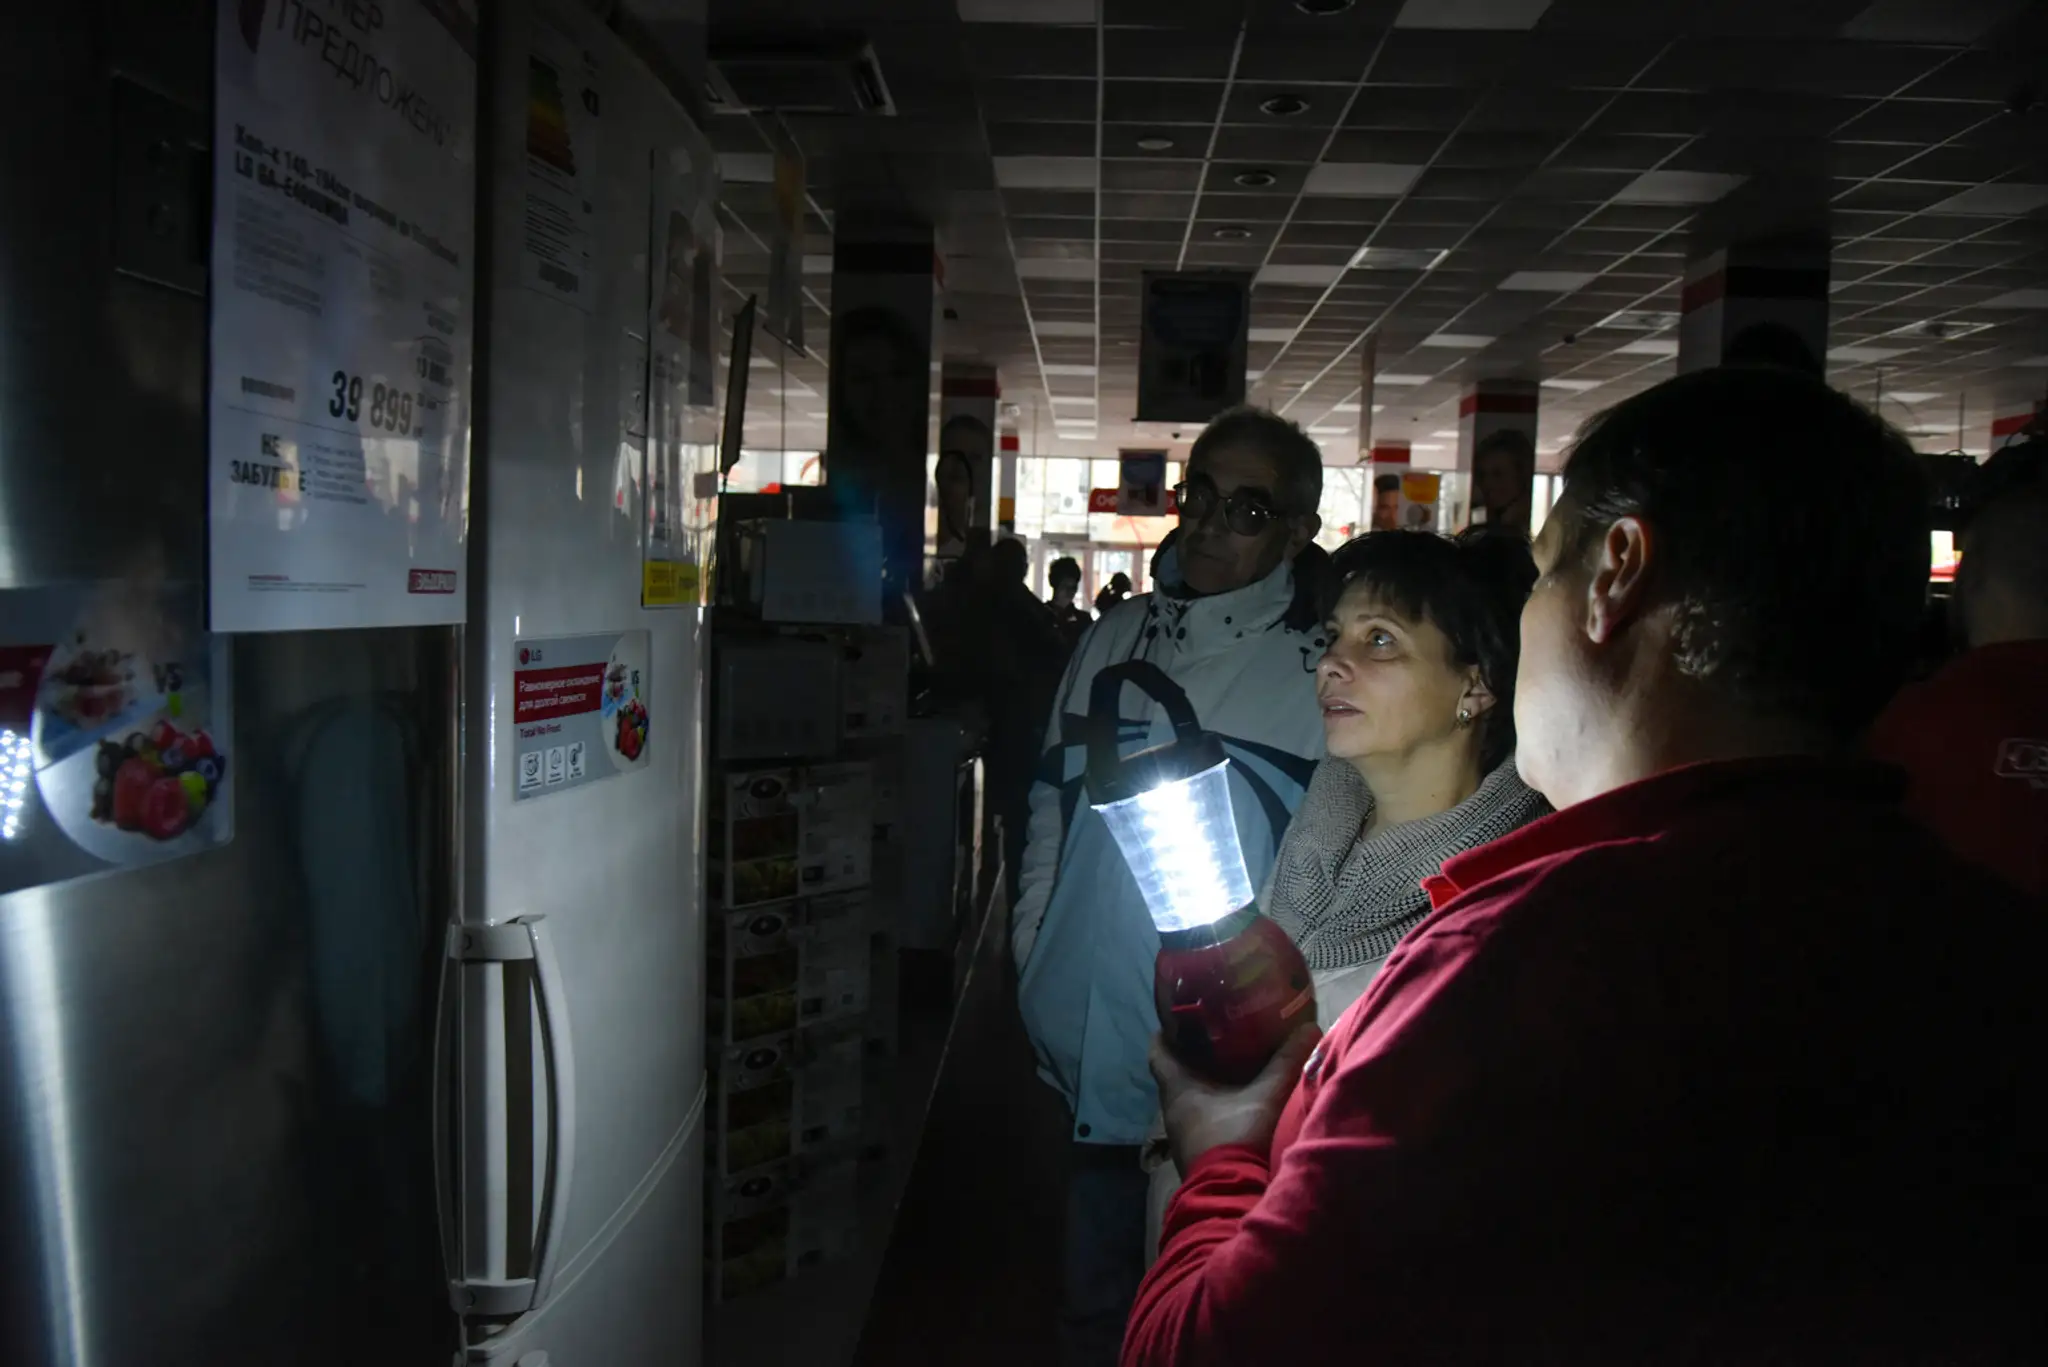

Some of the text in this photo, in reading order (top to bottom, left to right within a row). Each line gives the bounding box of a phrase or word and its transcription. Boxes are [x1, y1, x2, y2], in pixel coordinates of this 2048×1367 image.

[330, 370, 363, 422] 39
[370, 382, 412, 436] 899
[260, 432, 281, 459] НЕ
[531, 649, 542, 661] LG
